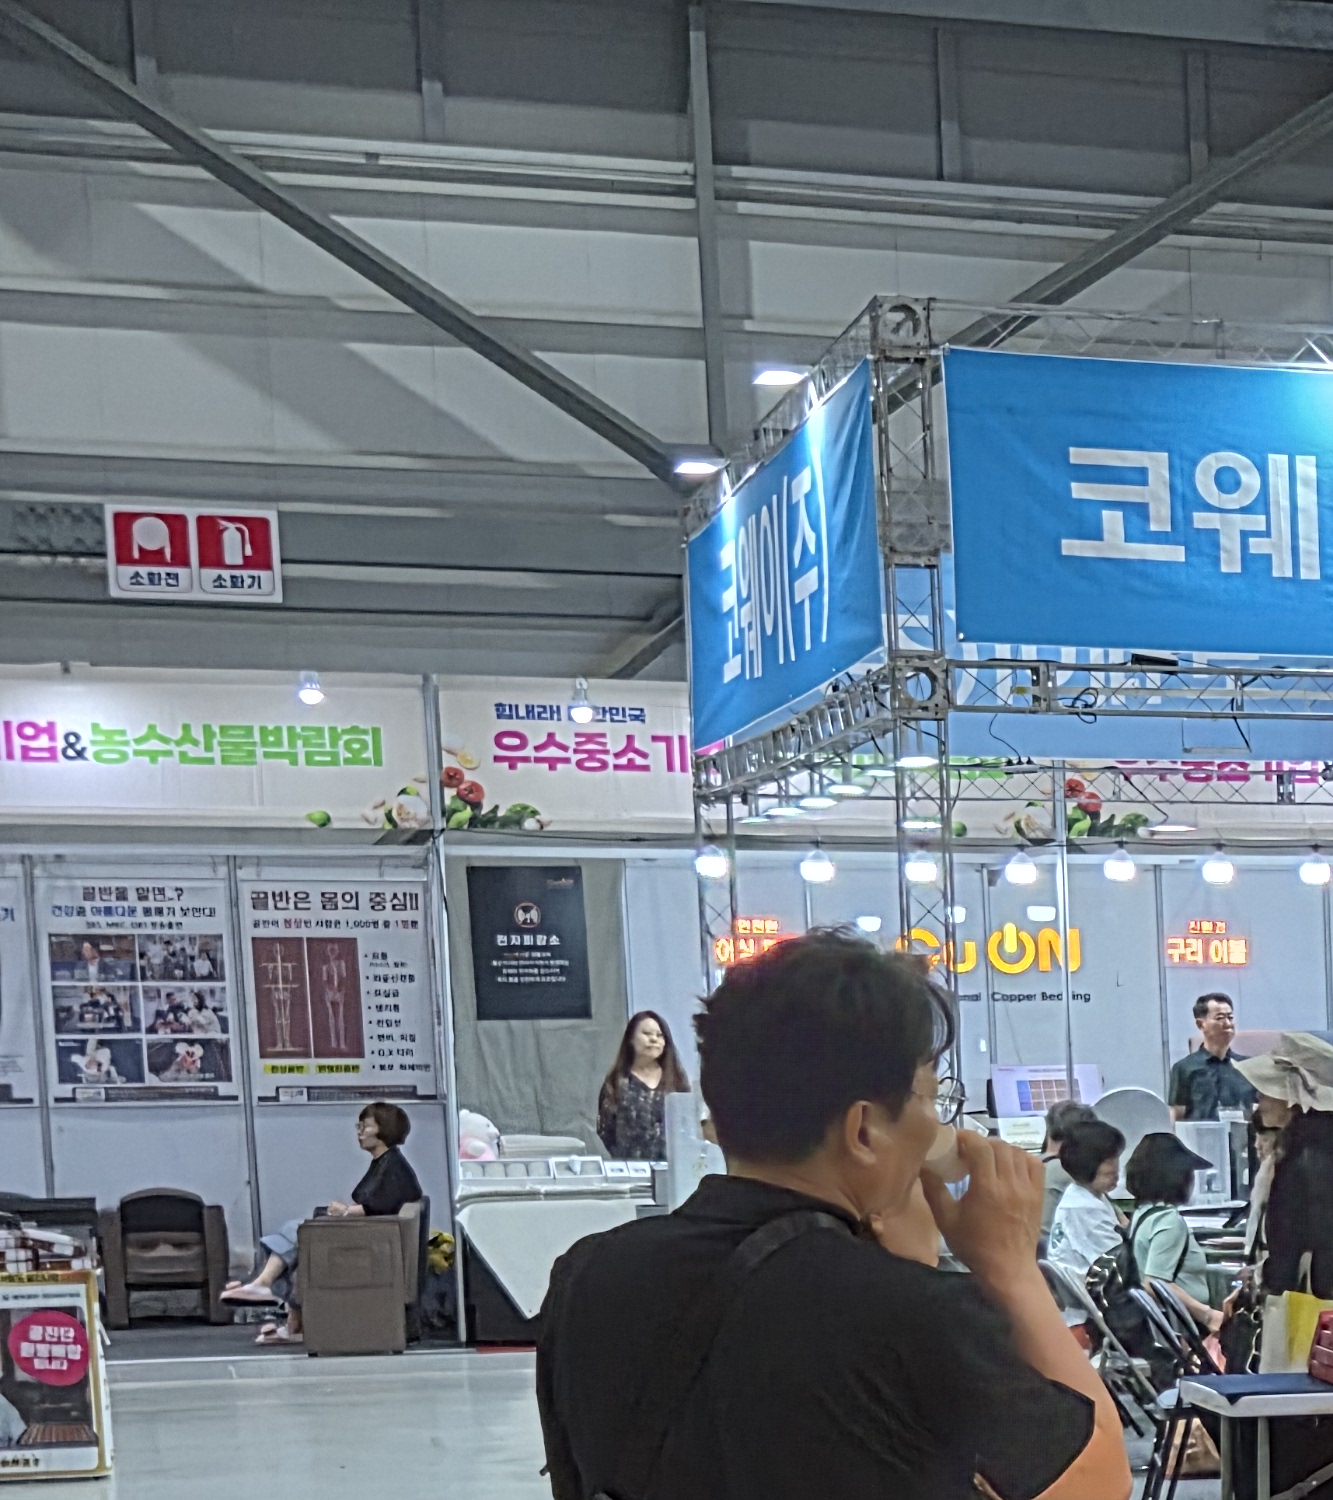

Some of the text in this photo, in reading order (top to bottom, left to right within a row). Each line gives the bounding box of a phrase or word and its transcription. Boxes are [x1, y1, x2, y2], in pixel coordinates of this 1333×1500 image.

[129, 571, 181, 588] 소화전
[212, 573, 263, 591] 소화기
[721, 462, 831, 686] 코웨이(주)
